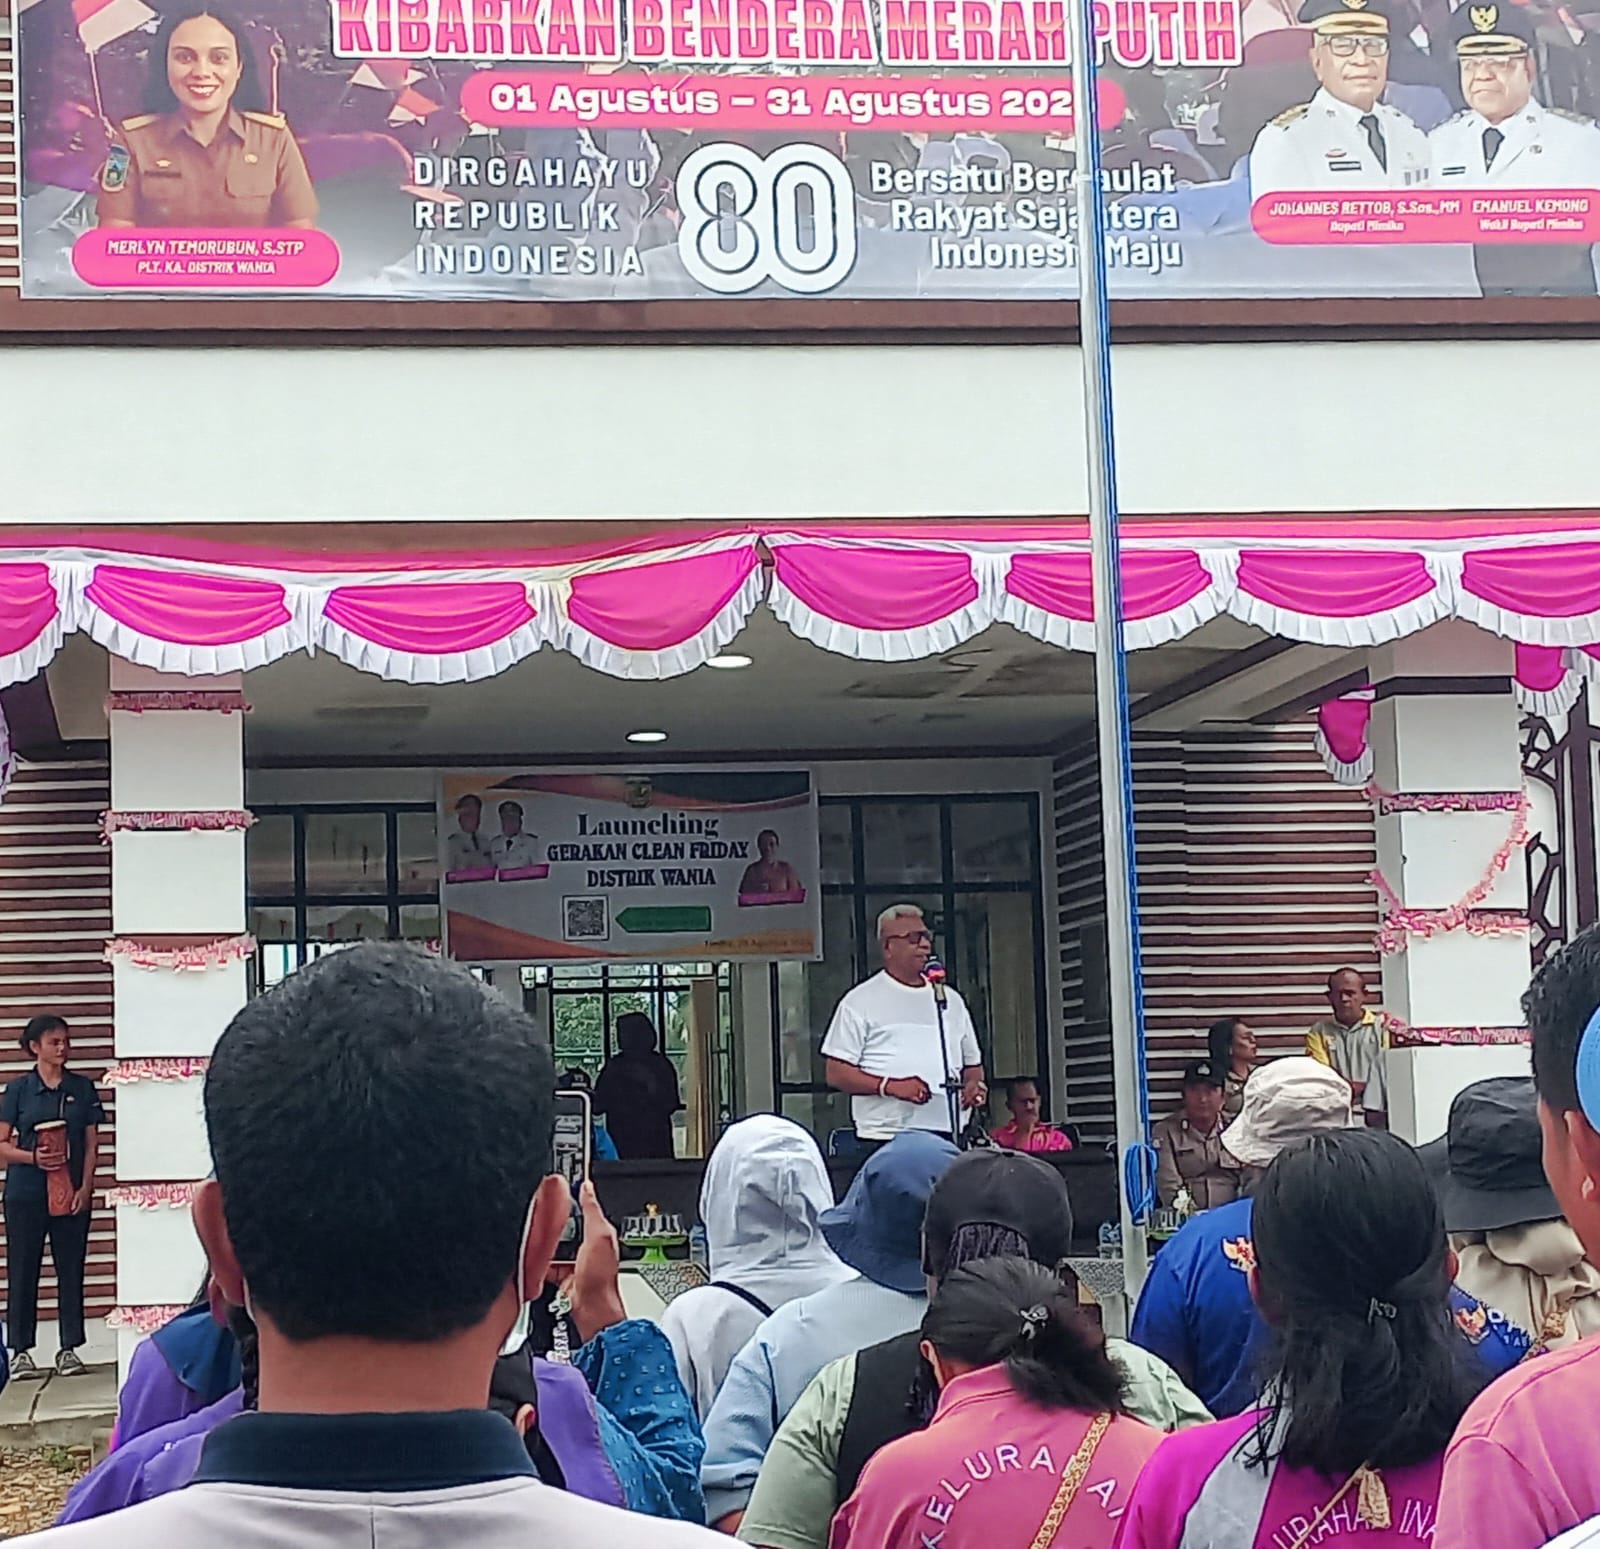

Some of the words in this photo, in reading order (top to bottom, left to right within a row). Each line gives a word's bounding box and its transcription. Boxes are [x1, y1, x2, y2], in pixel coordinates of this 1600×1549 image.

[338, 0, 616, 56] KIBARKAN
[632, 0, 873, 59] BENDERA
[885, 0, 1066, 60] MERAH
[1093, 0, 1236, 61] PUTIH
[490, 83, 537, 112] 01
[548, 83, 720, 121] Agustus
[766, 87, 812, 116] 31
[823, 88, 992, 124] Agustus
[1001, 89, 1073, 117] 202
[414, 157, 649, 189] DIRGAHAYU
[870, 160, 1005, 193] Bersatu
[414, 201, 620, 230] REPUBLIK
[677, 142, 856, 294] 80
[892, 200, 1009, 237] Rakyat
[1270, 200, 1339, 215] JOHANNES
[1341, 200, 1394, 217] RETTOB,
[1472, 199, 1534, 213] EMANUEL
[107, 240, 166, 255] MERLYN
[168, 240, 260, 257] TEMORUBUN,
[262, 241, 305, 255] S.STP
[416, 244, 644, 275] INDONESIA
[931, 238, 1078, 269] Indonesi
[1105, 236, 1182, 274] Maju
[137, 261, 163, 274] PLT.
[164, 261, 186, 274] KA.
[187, 261, 234, 274] DISTRIK
[236, 261, 276, 274] WANIA
[577, 813, 719, 838] Launching
[547, 843, 627, 862] GERAKAN
[632, 842, 684, 861] CLEAN
[690, 841, 750, 859] FRIDAY
[587, 869, 656, 888] DISTRIK
[660, 868, 716, 886] WANIA
